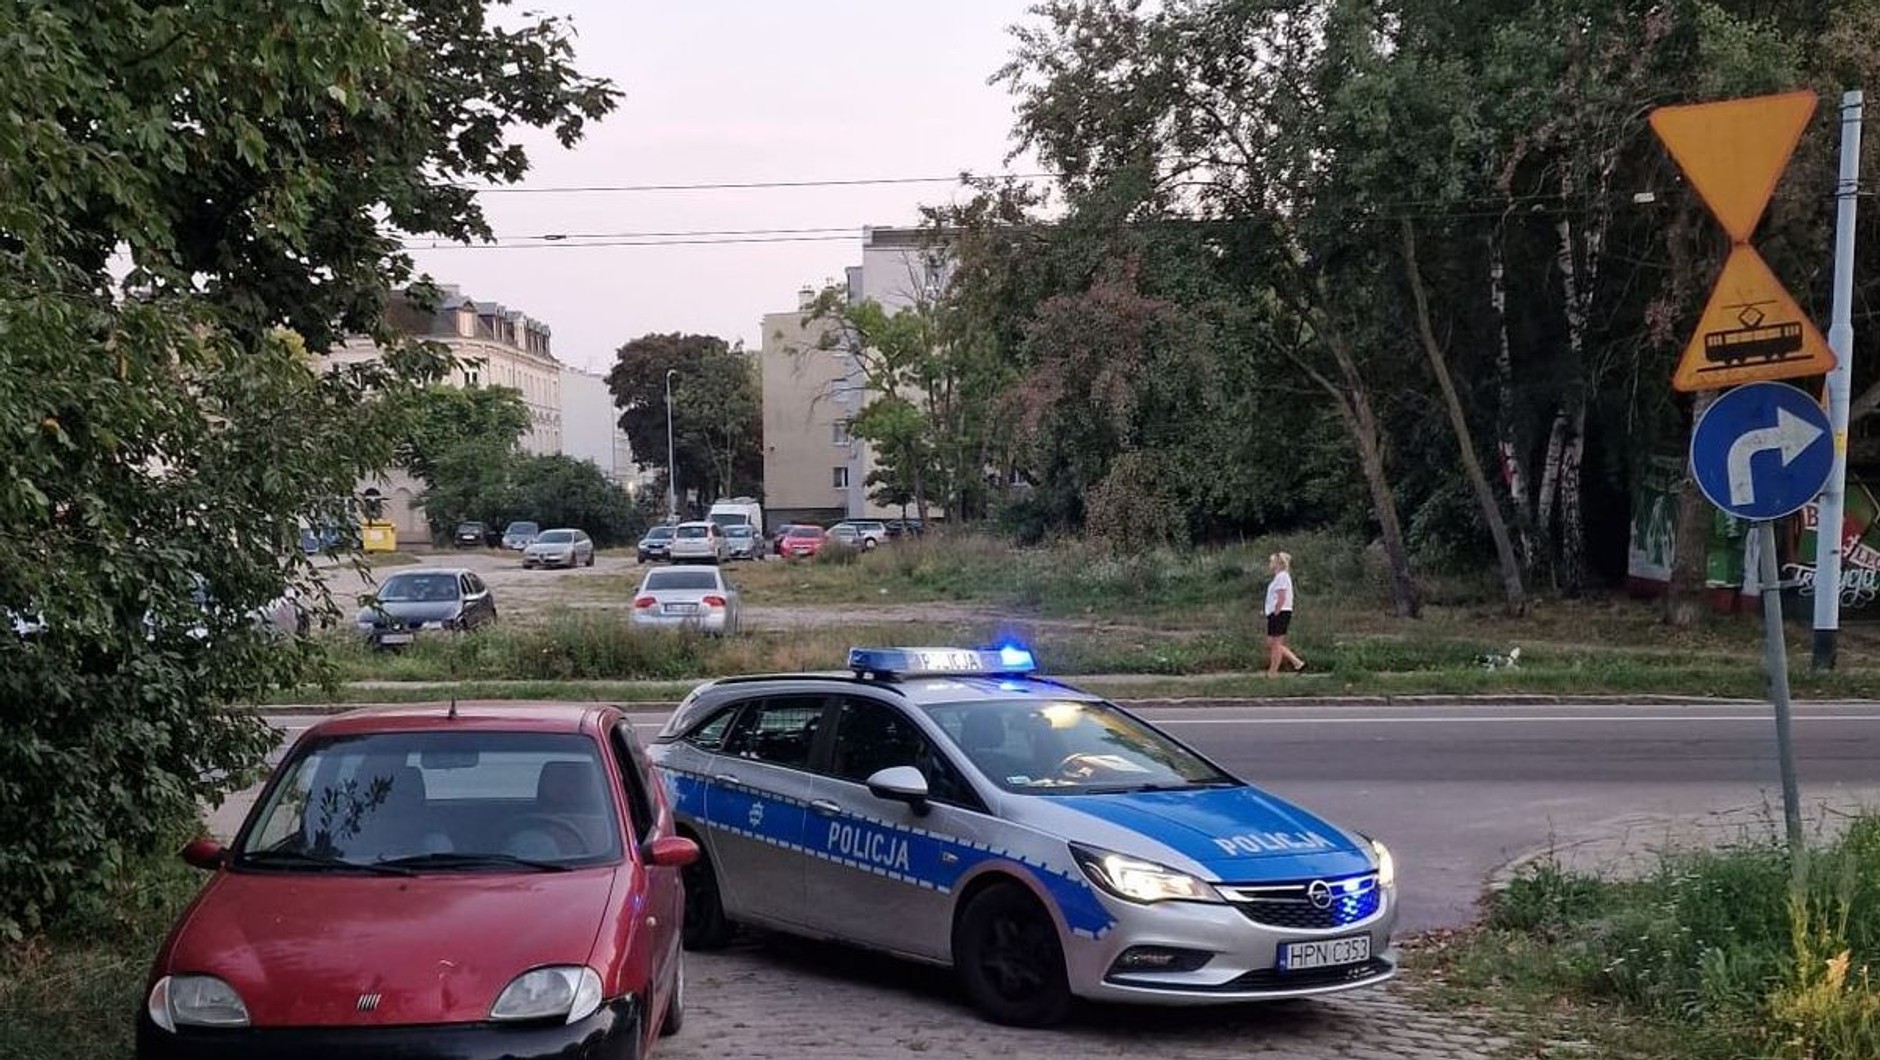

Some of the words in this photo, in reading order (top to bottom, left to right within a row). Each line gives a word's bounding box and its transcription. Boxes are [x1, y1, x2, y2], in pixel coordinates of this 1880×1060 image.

[921, 652, 980, 671] PICJA
[827, 820, 911, 871] POLICJA
[1213, 830, 1337, 856] POLICJA
[1291, 944, 1328, 967] HPN
[1333, 938, 1368, 963] C353
